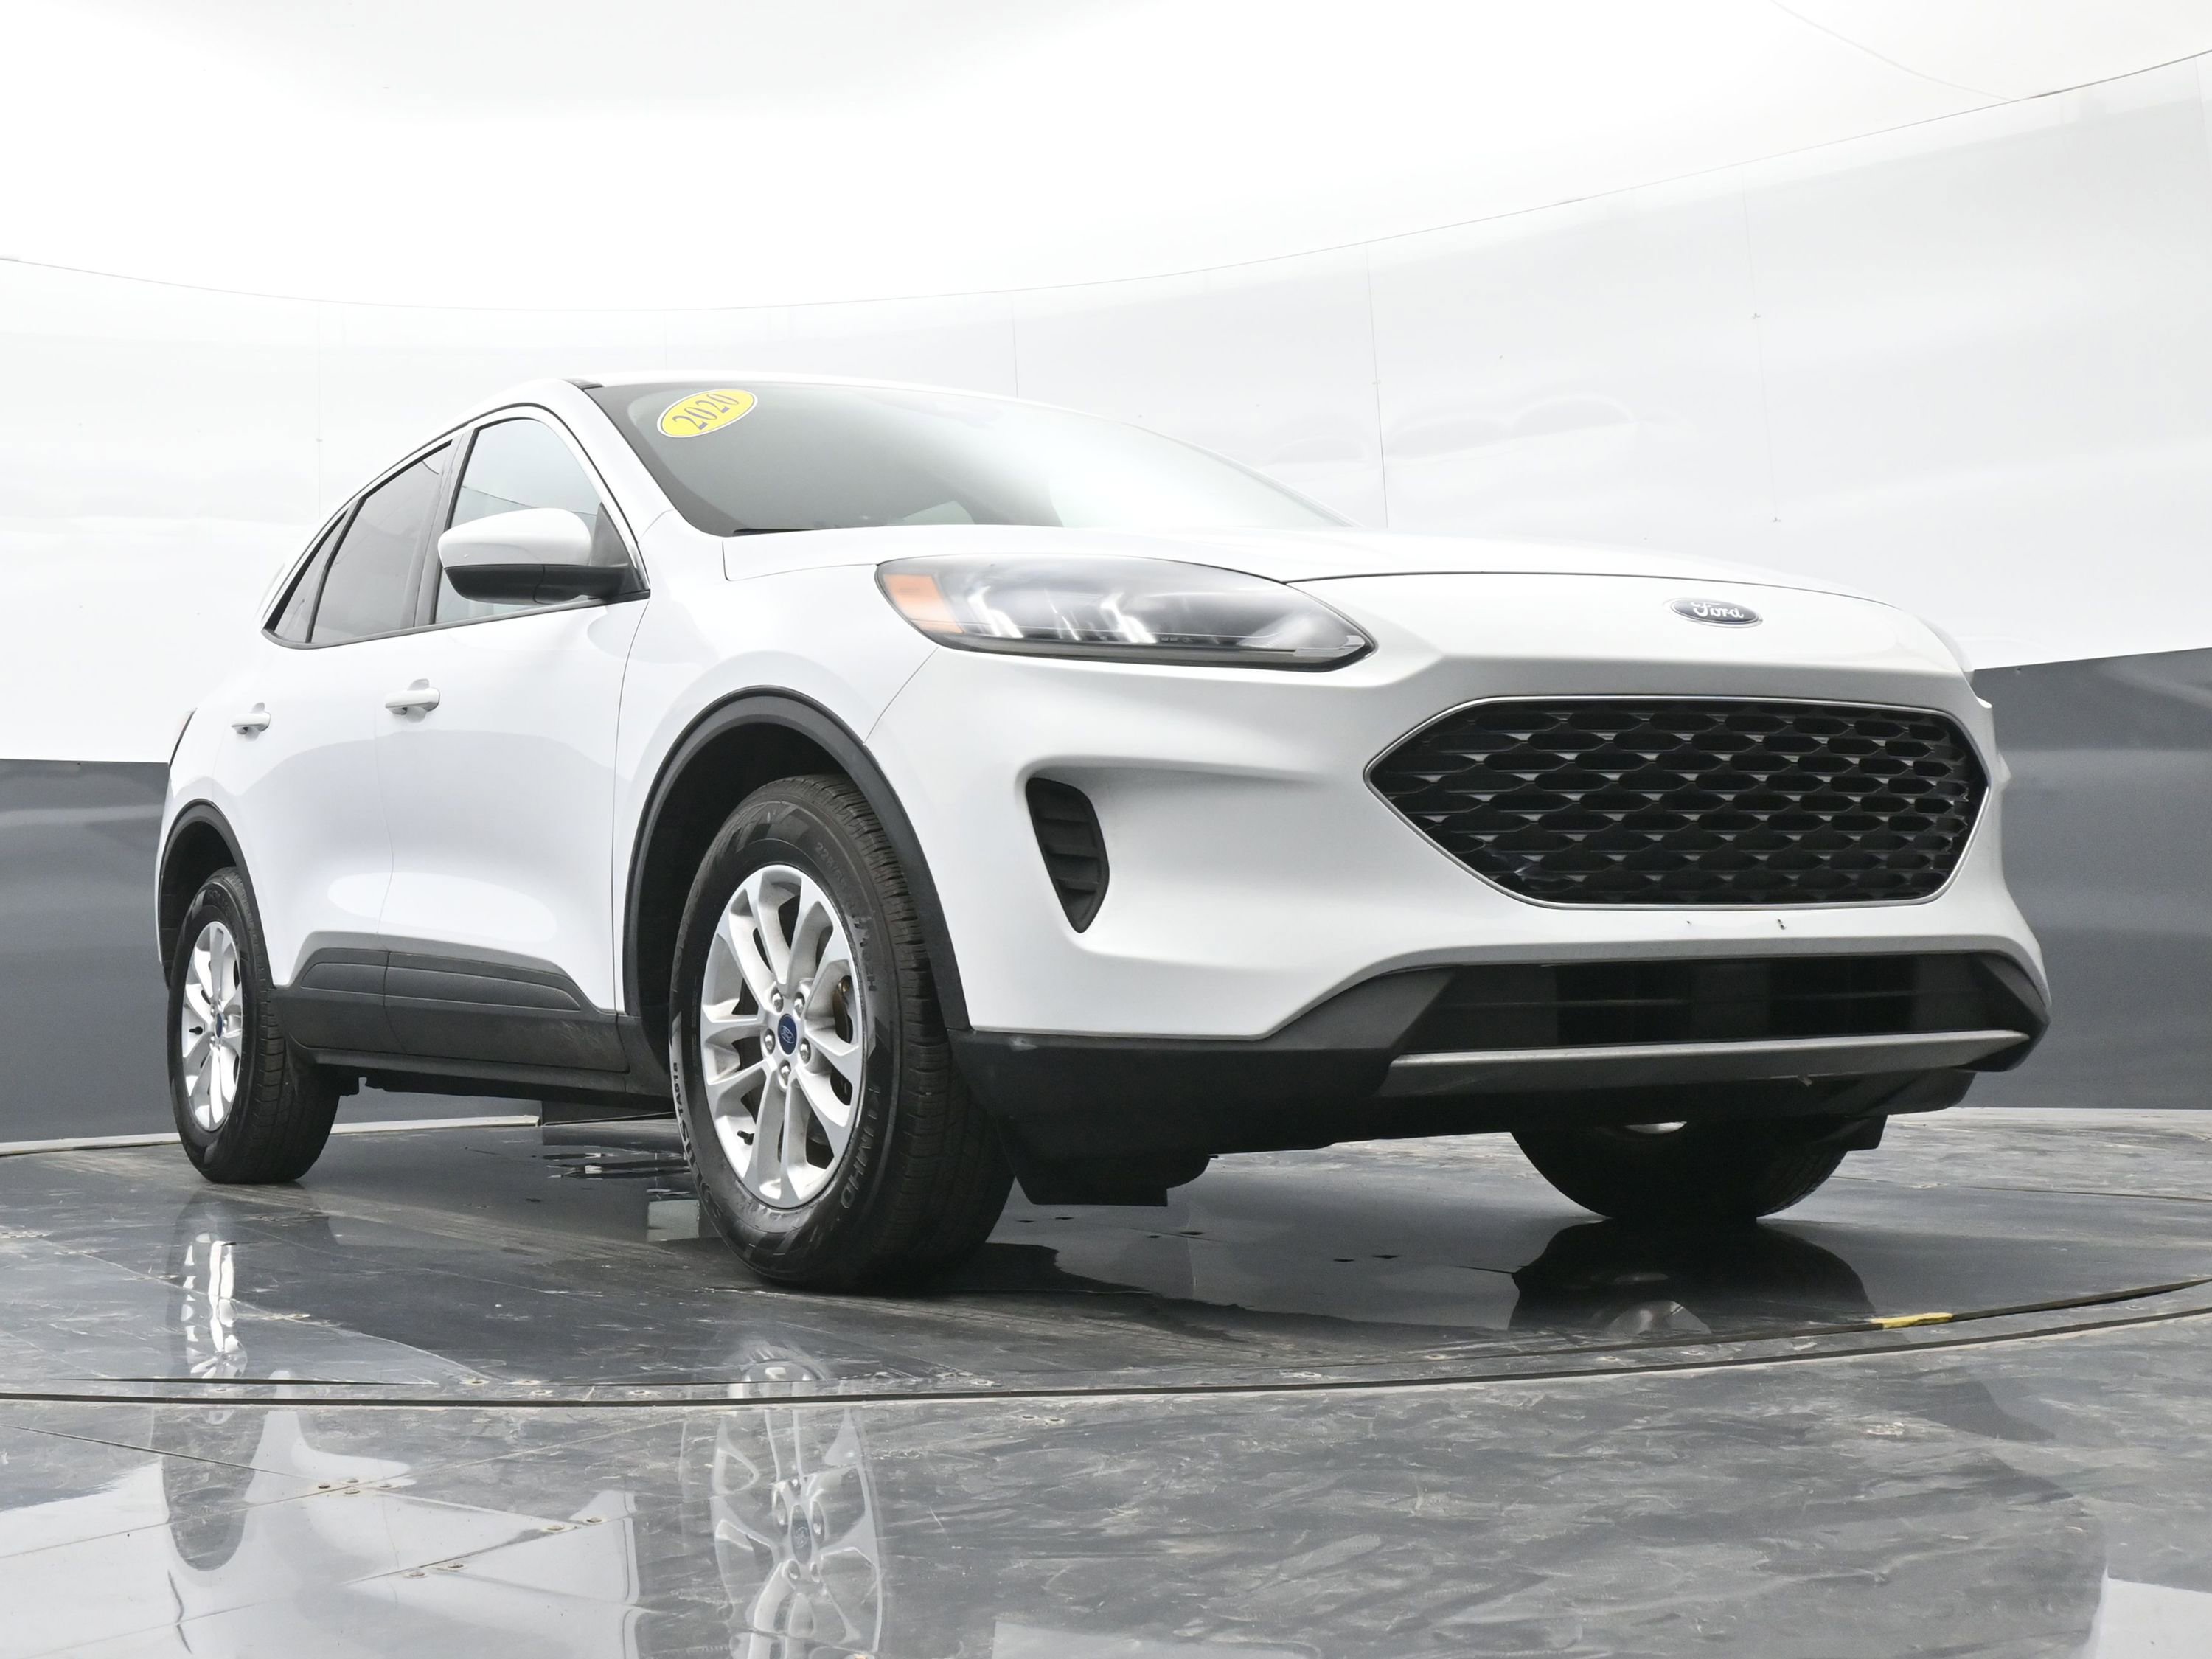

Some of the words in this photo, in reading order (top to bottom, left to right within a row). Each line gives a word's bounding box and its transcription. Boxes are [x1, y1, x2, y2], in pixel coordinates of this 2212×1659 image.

[672, 394, 740, 430] 2020
[1691, 602, 1745, 619] Ford
[680, 1119, 723, 1219] SOLUS
[841, 1085, 882, 1209] KUMHO
